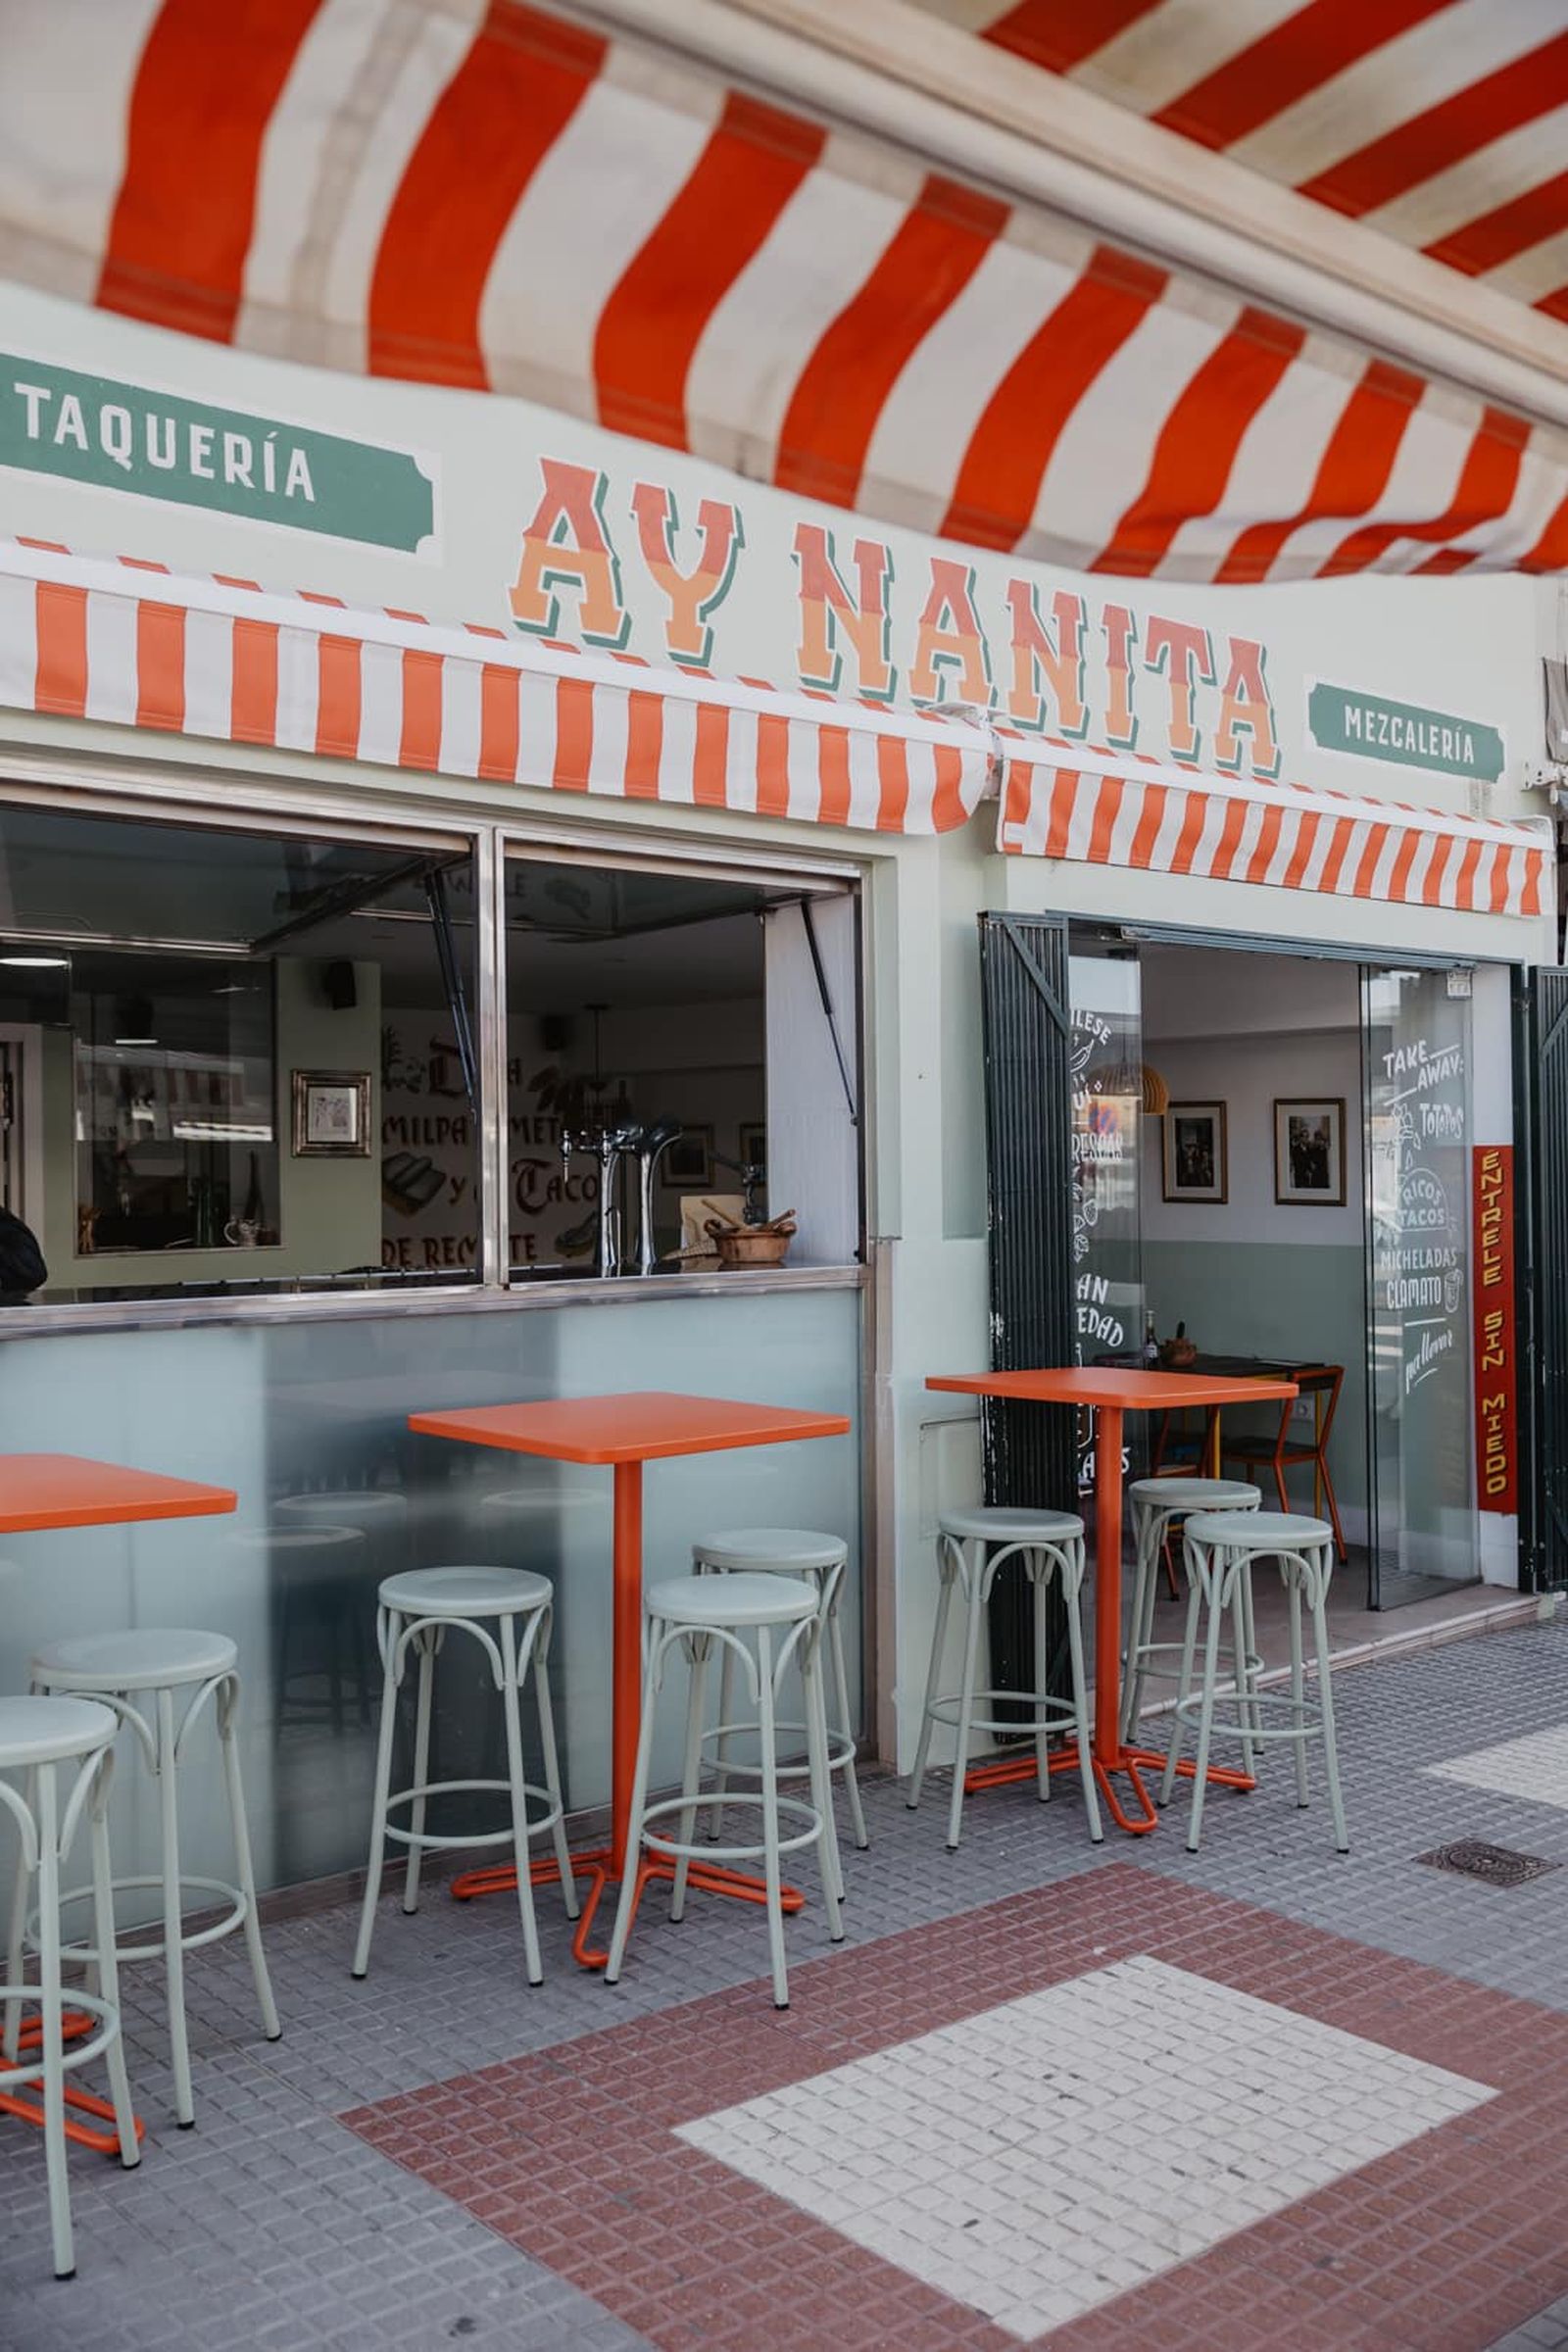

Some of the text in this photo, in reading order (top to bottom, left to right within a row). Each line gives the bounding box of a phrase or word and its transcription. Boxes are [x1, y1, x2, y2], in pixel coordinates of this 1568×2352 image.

[14, 382, 315, 502] TAQUERÍA
[508, 454, 1282, 778] AY NANITA
[1344, 705, 1474, 764] MEZCALERÍA
[1383, 1040, 1428, 1079] TAKE
[1402, 1179, 1442, 1205] RICOS
[1396, 1208, 1445, 1226] TACOS
[1381, 1248, 1457, 1270] MICHELADAS
[1387, 1276, 1441, 1309] CLAMATO
[1482, 1310, 1504, 1371] SIN
[1483, 1394, 1506, 1494] MIEDO
